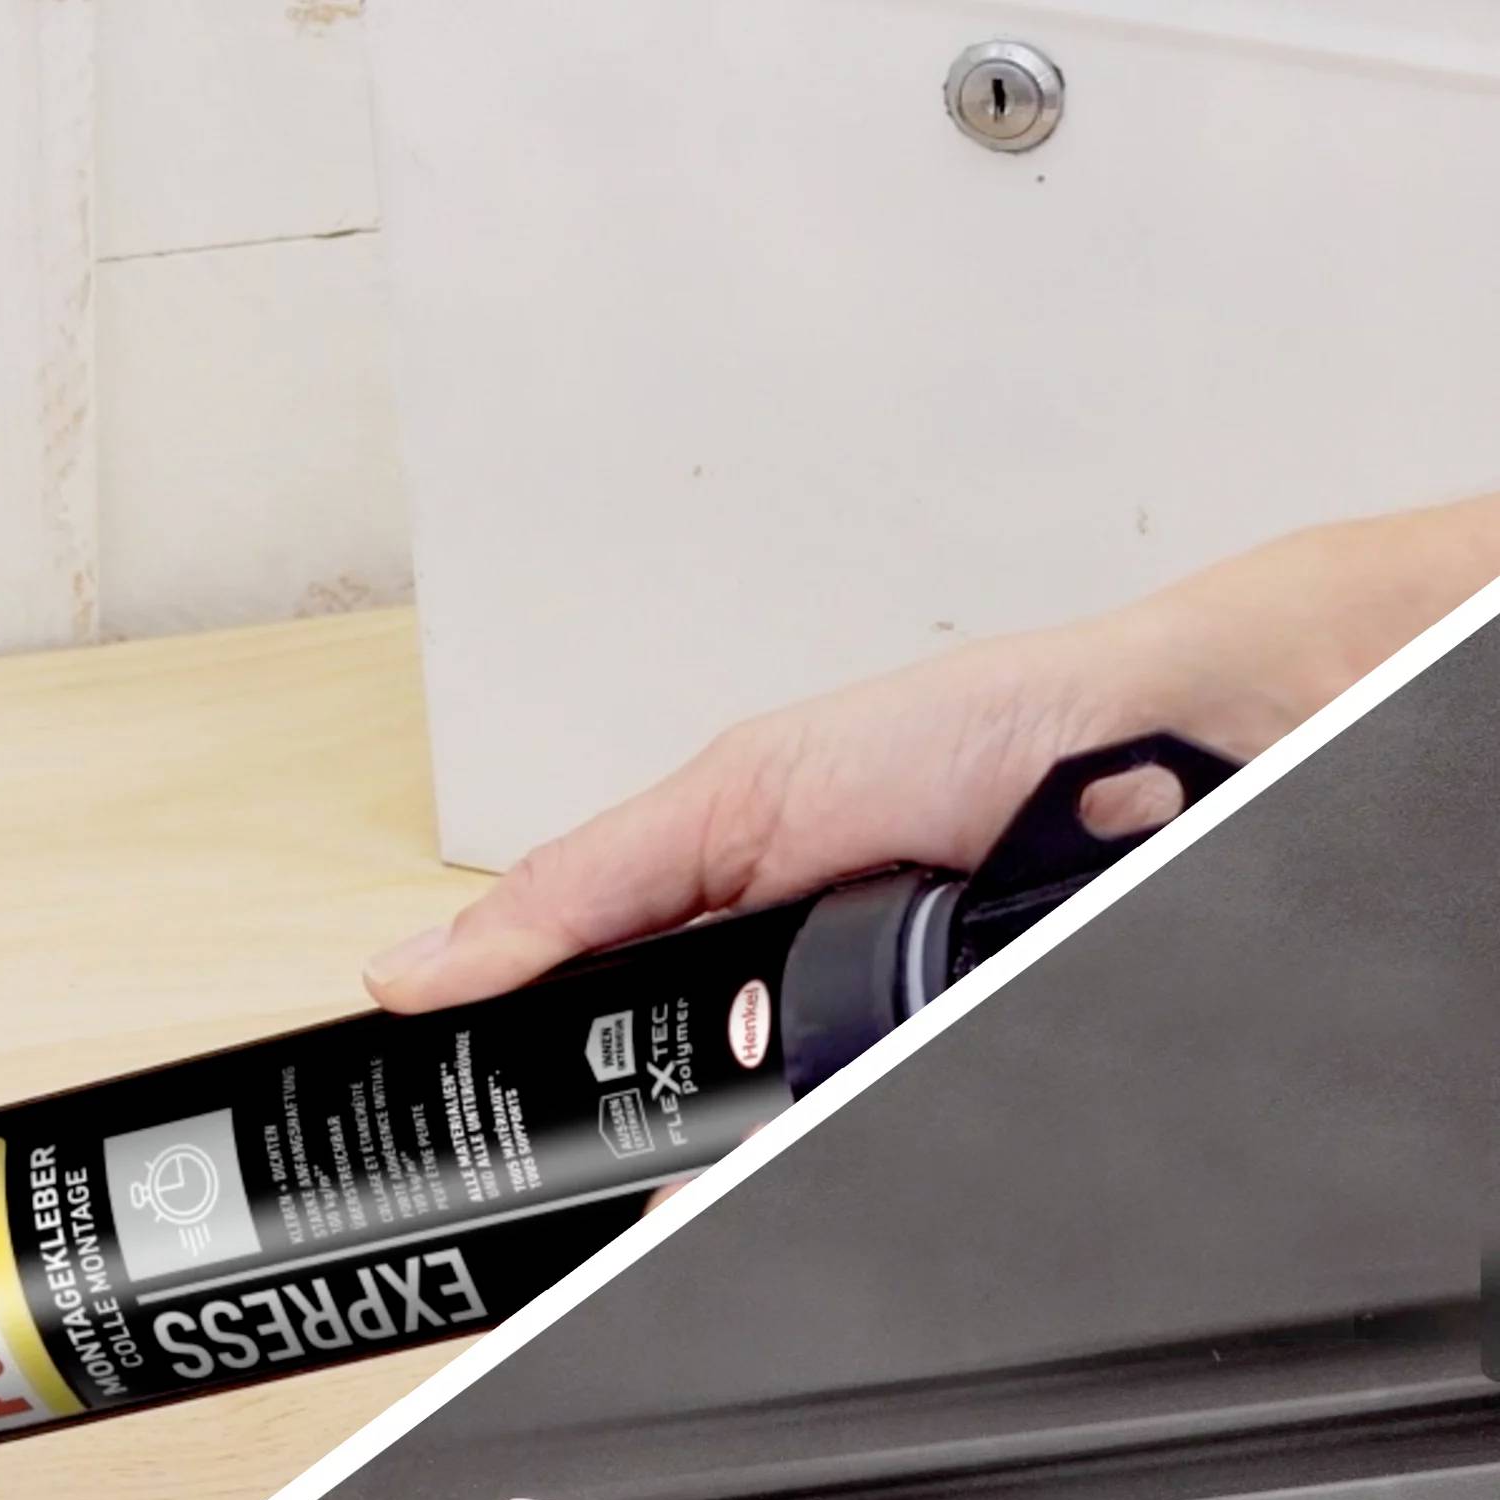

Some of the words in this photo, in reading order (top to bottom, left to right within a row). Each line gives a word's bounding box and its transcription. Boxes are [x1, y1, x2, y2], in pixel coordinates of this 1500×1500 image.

[674, 997, 699, 1095] polymer
[742, 986, 760, 1061] Henkel
[264, 1125, 287, 1182] DICHTEN
[469, 1132, 493, 1168] ALLE
[505, 1087, 533, 1156] SUPPORTS
[460, 1167, 484, 1202] ALLE
[480, 1170, 500, 1200] UND
[506, 1159, 528, 1193] TOUS
[64, 1166, 114, 1296] MONTAGE
[30, 1144, 129, 1397] MONTAGEKLEBER
[90, 1297, 144, 1369] COLLE
[152, 1247, 489, 1379] EXPRESS
